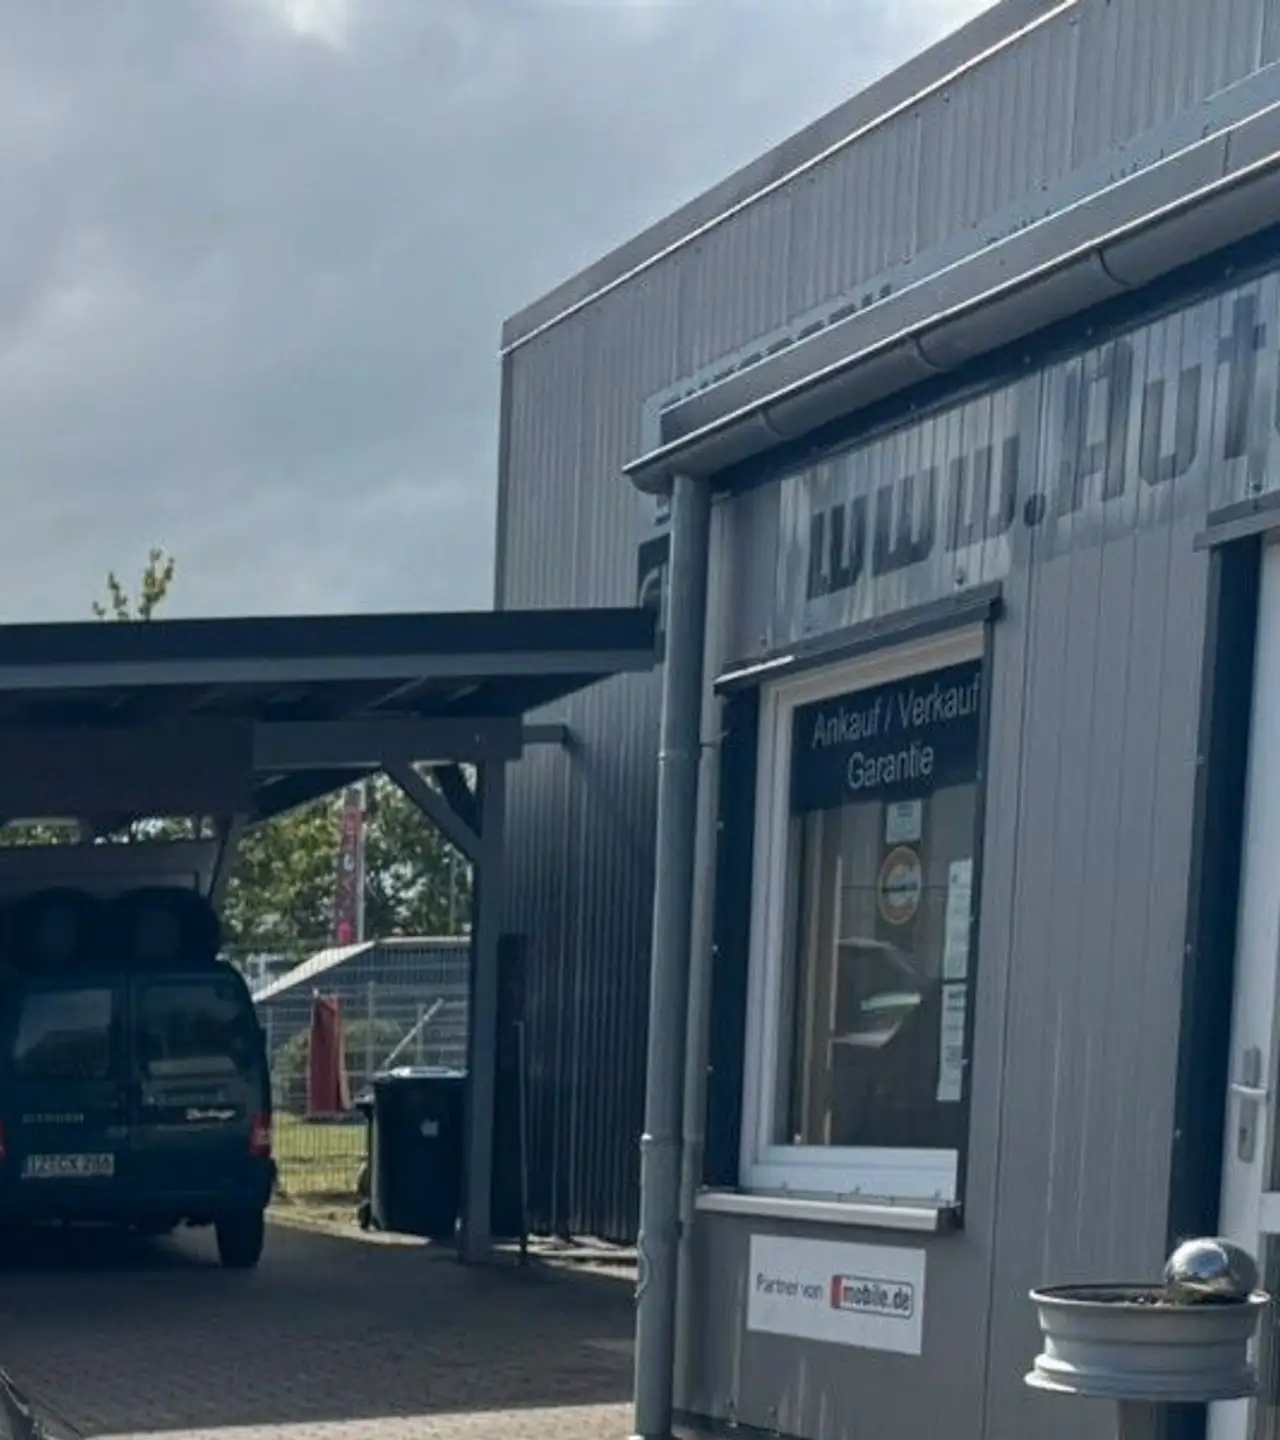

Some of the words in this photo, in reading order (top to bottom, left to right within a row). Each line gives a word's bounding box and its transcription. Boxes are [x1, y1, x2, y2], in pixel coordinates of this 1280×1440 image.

[812, 694, 881, 749] Ankauf
[883, 695, 892, 732] /
[898, 673, 980, 729] Verkauf
[847, 740, 934, 790] Garantie
[756, 1272, 798, 1298] Partner
[801, 1281, 822, 1300] von
[843, 1281, 910, 1311] mobile.de
